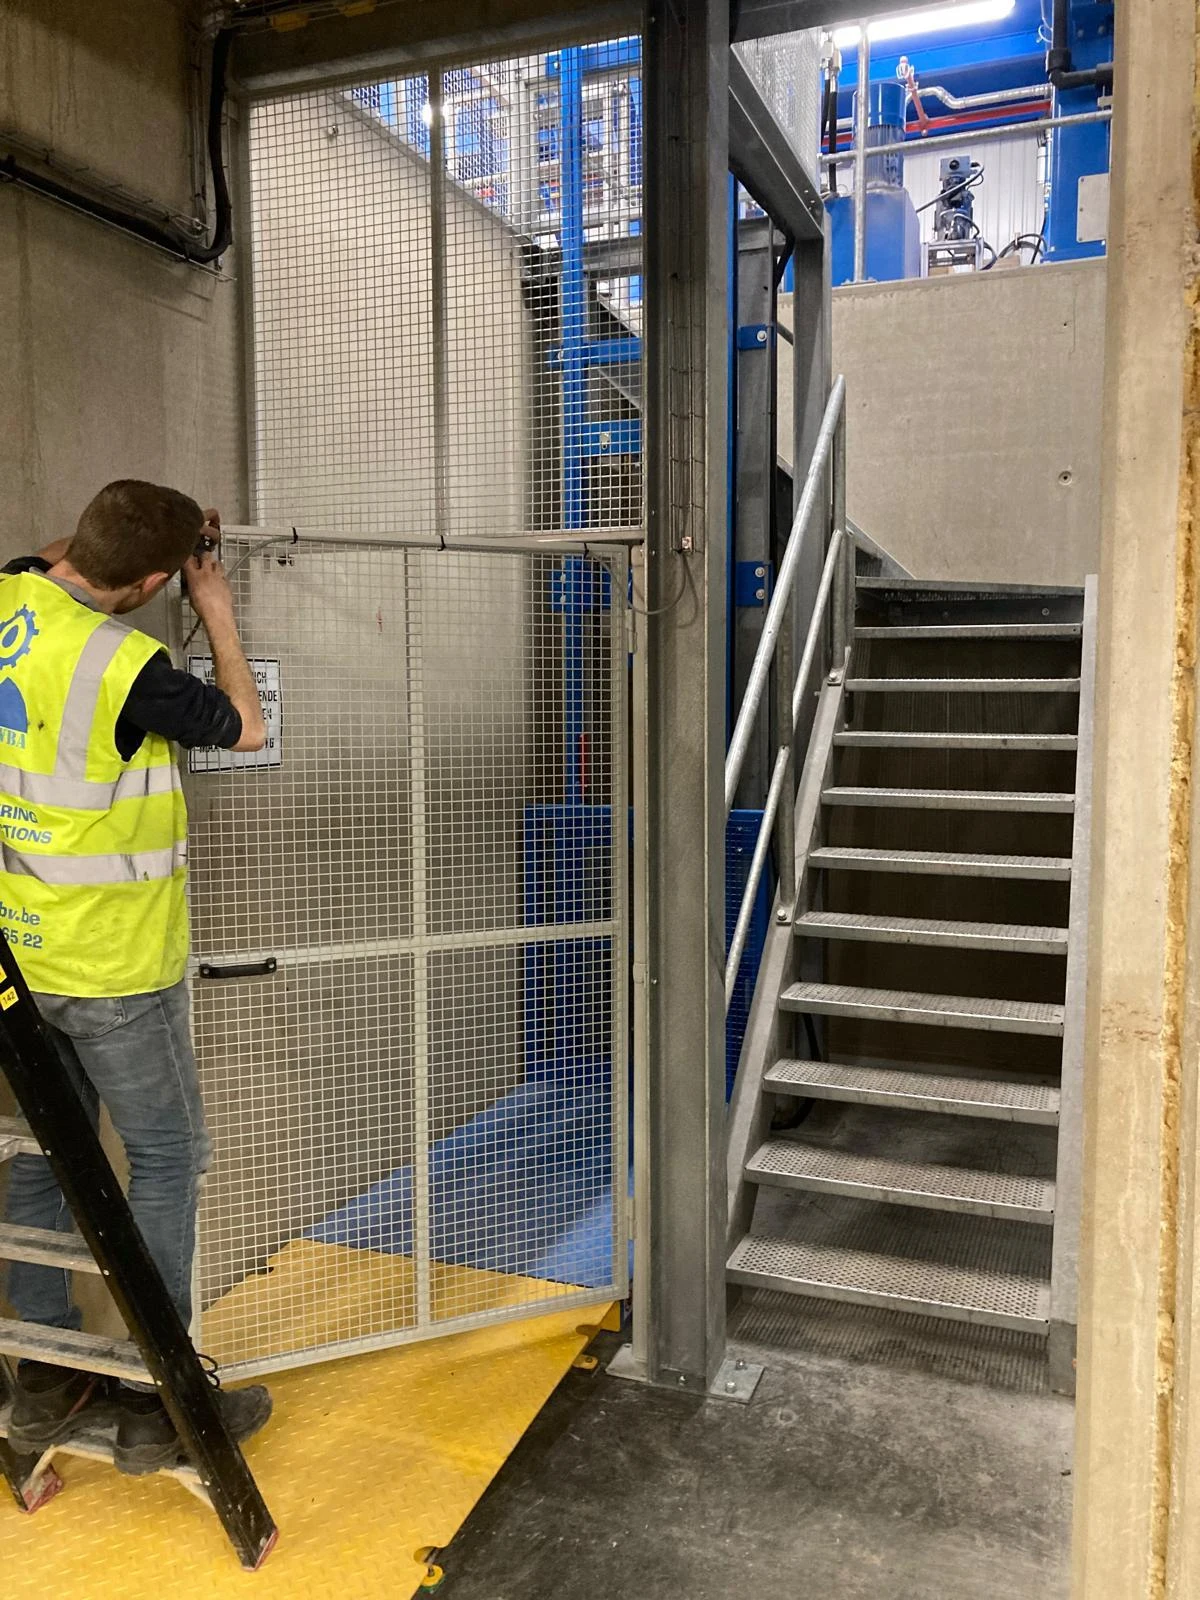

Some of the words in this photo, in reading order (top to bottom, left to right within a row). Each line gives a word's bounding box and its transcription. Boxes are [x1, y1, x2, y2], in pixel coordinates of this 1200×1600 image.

[258, 690, 278, 702] ENDE
[262, 708, 272, 720] EN
[0, 804, 38, 823] RING
[0, 824, 52, 844] TIONS
[0, 901, 40, 926] bv.be
[22, 932, 43, 949] 22
